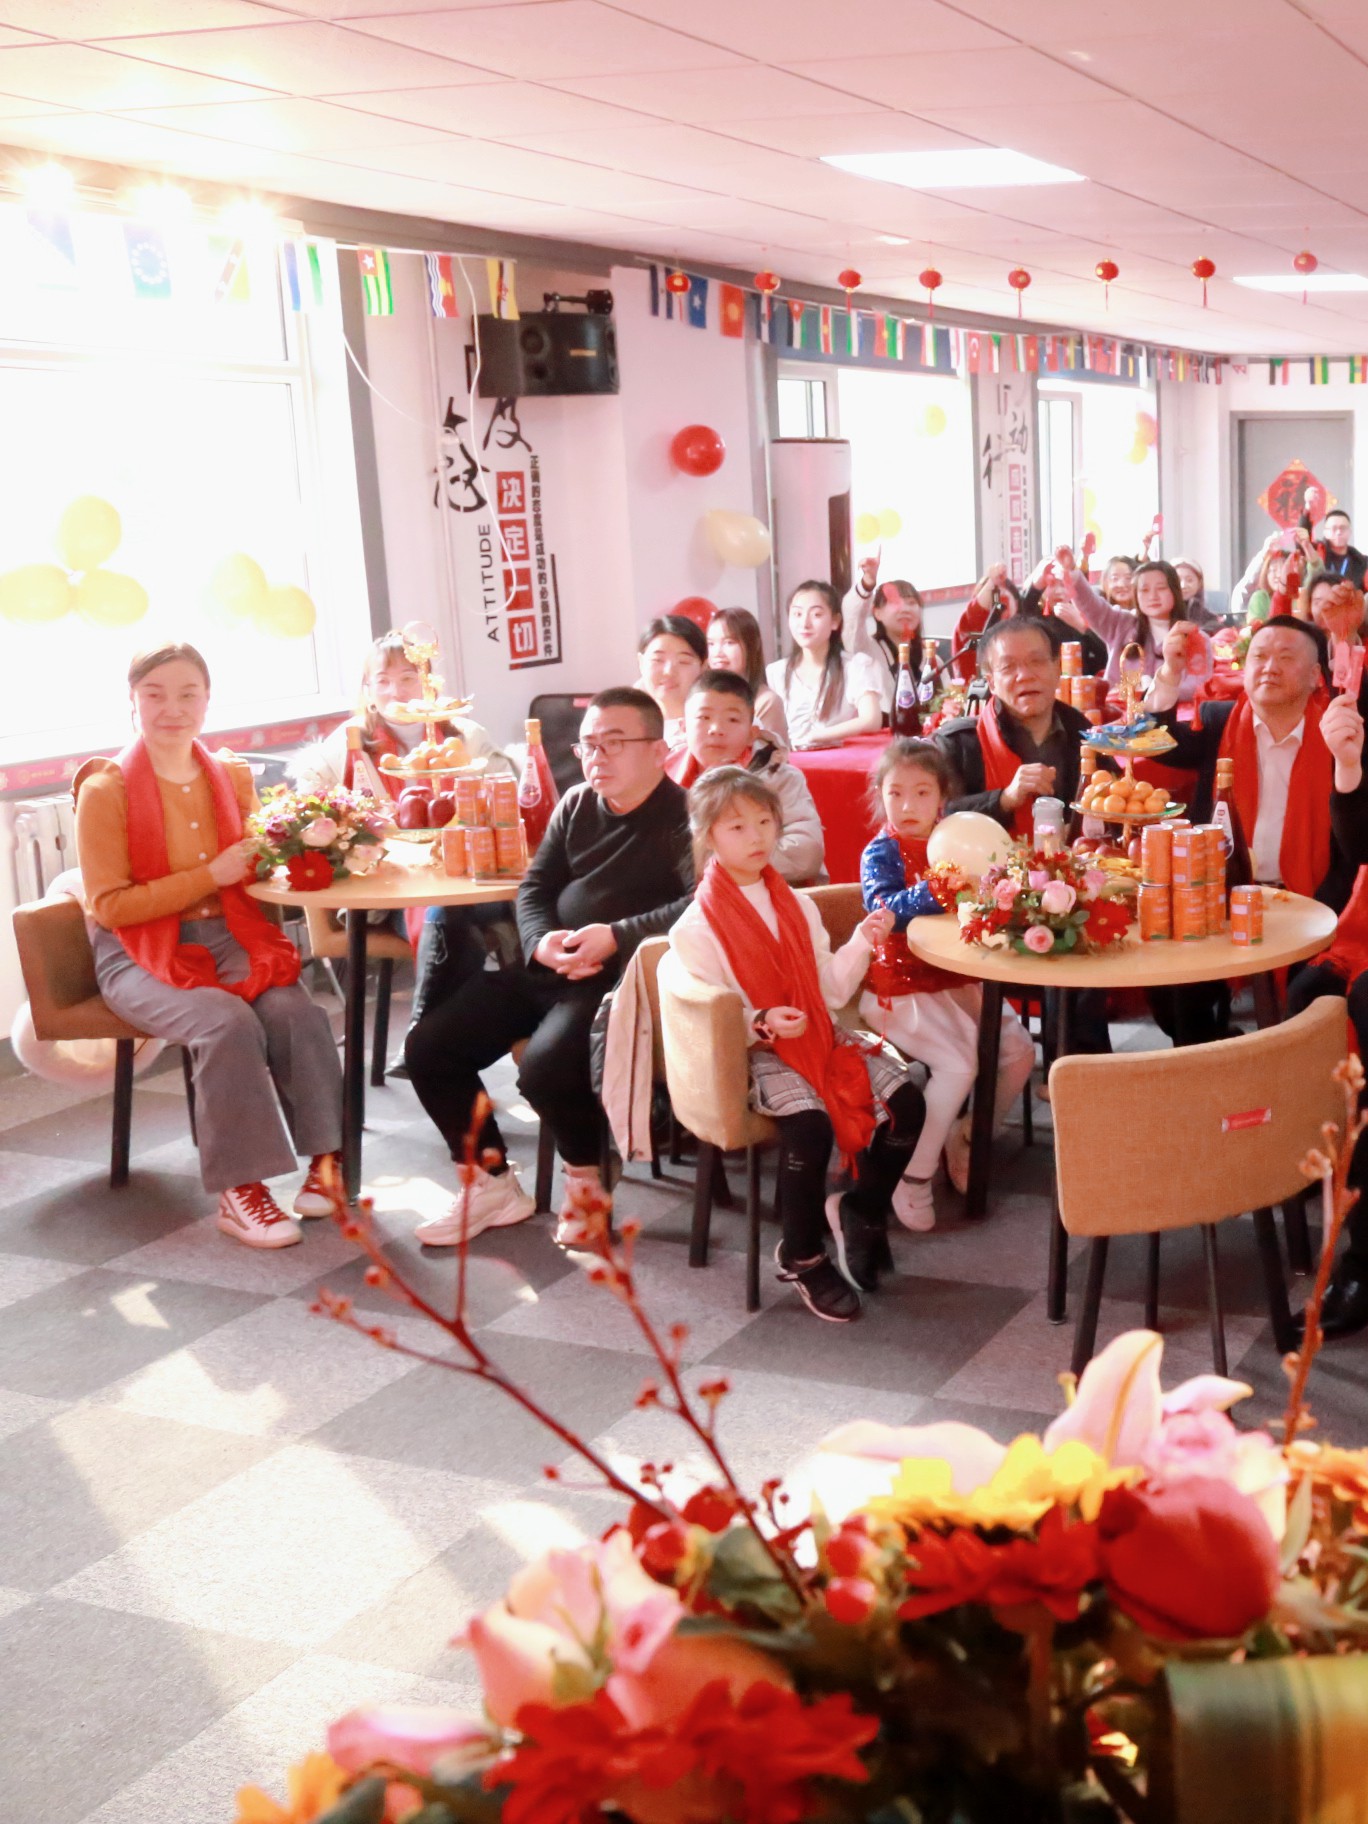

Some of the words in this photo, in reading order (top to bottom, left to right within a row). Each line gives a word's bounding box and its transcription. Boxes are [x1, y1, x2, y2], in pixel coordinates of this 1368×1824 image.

[478, 524, 500, 642] ATTITUDE
[498, 472, 538, 659] 决定一切
